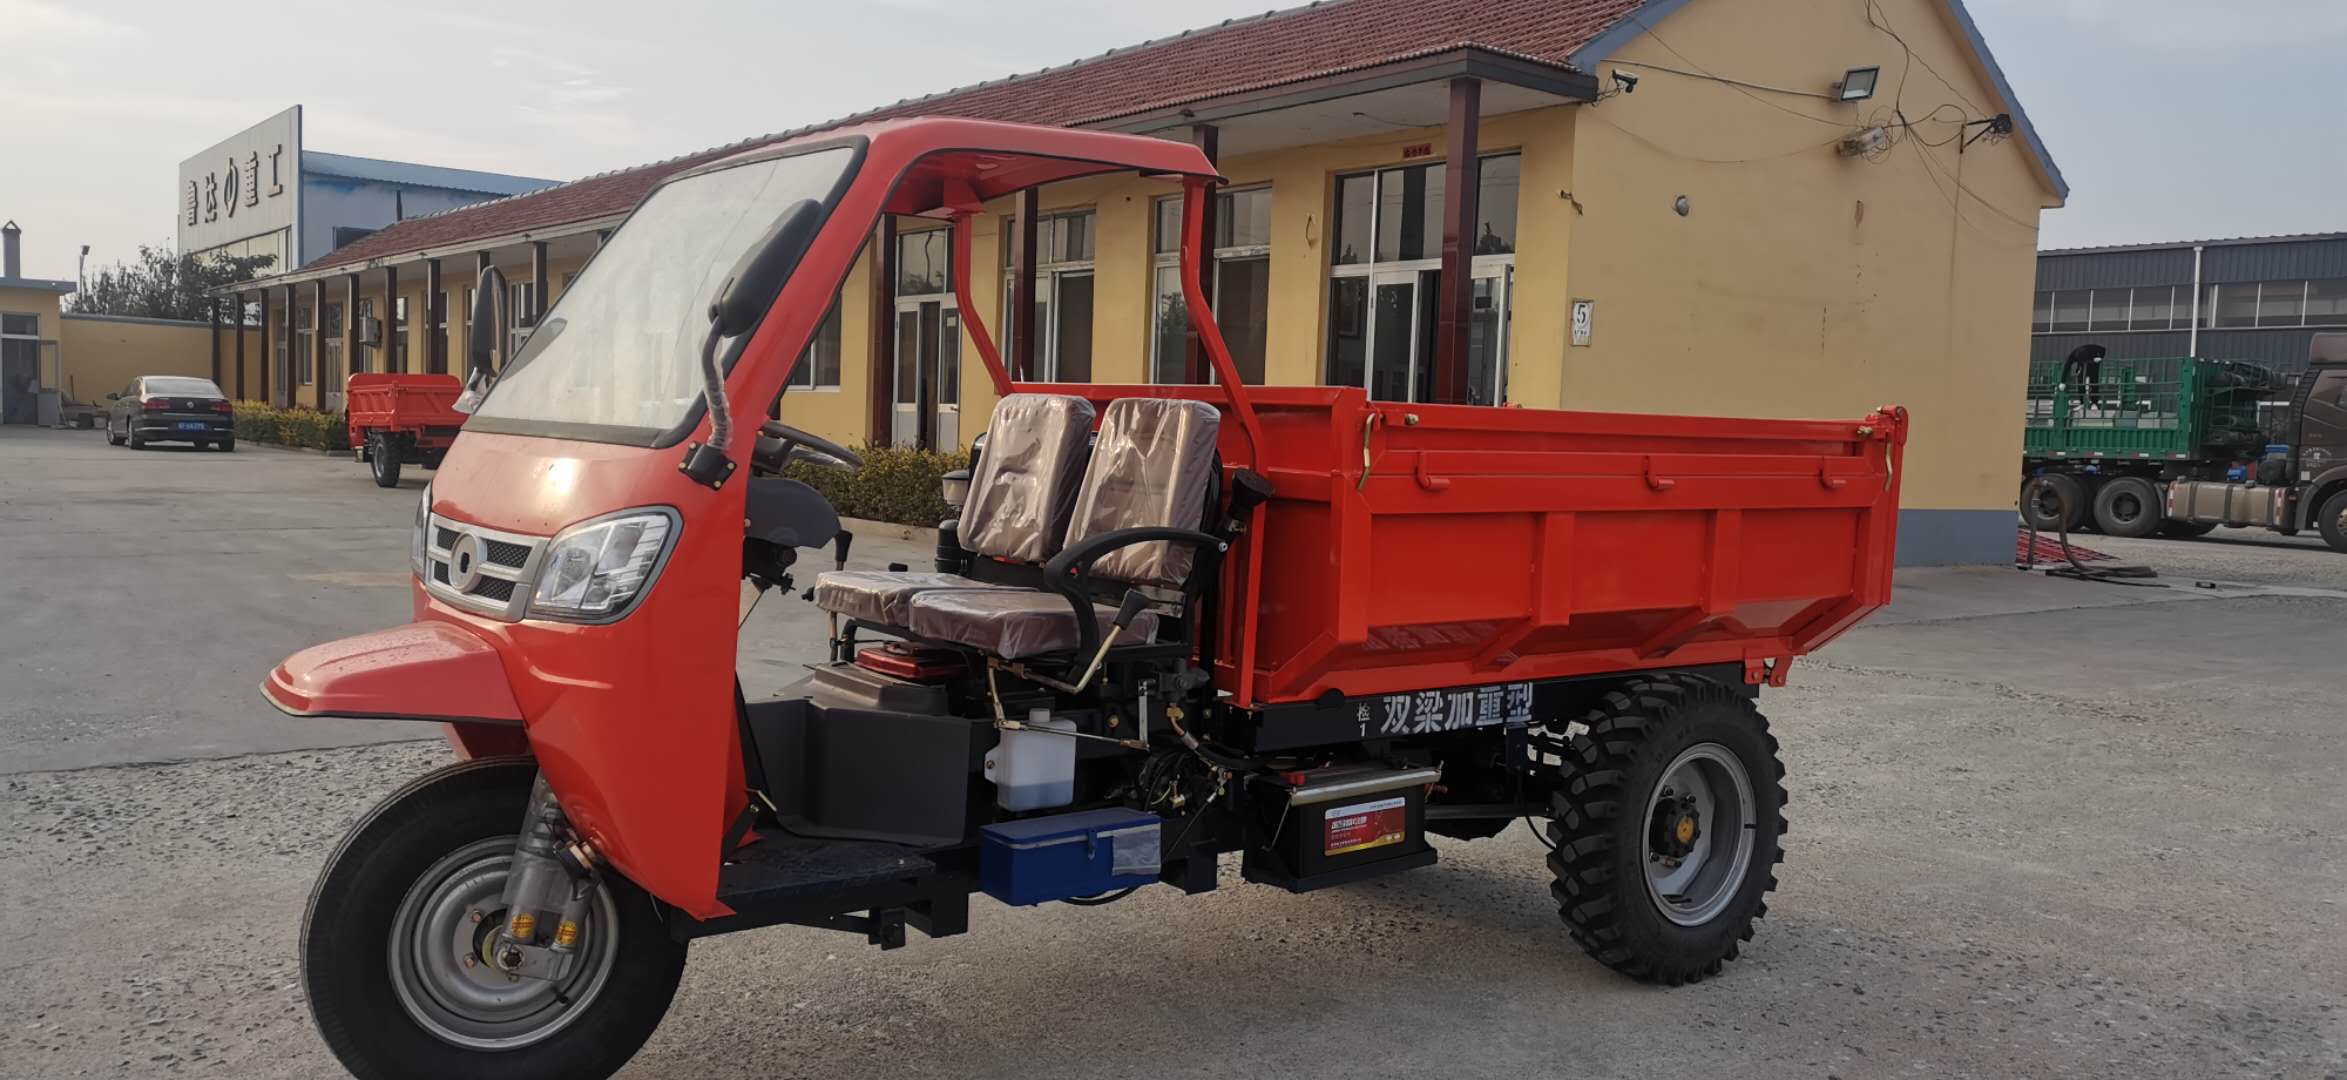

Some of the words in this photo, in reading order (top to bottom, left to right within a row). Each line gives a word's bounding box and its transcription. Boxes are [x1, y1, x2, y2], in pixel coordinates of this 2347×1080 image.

[1576, 303, 1587, 325] 5
[1380, 681, 1534, 735] 双梁加重型
